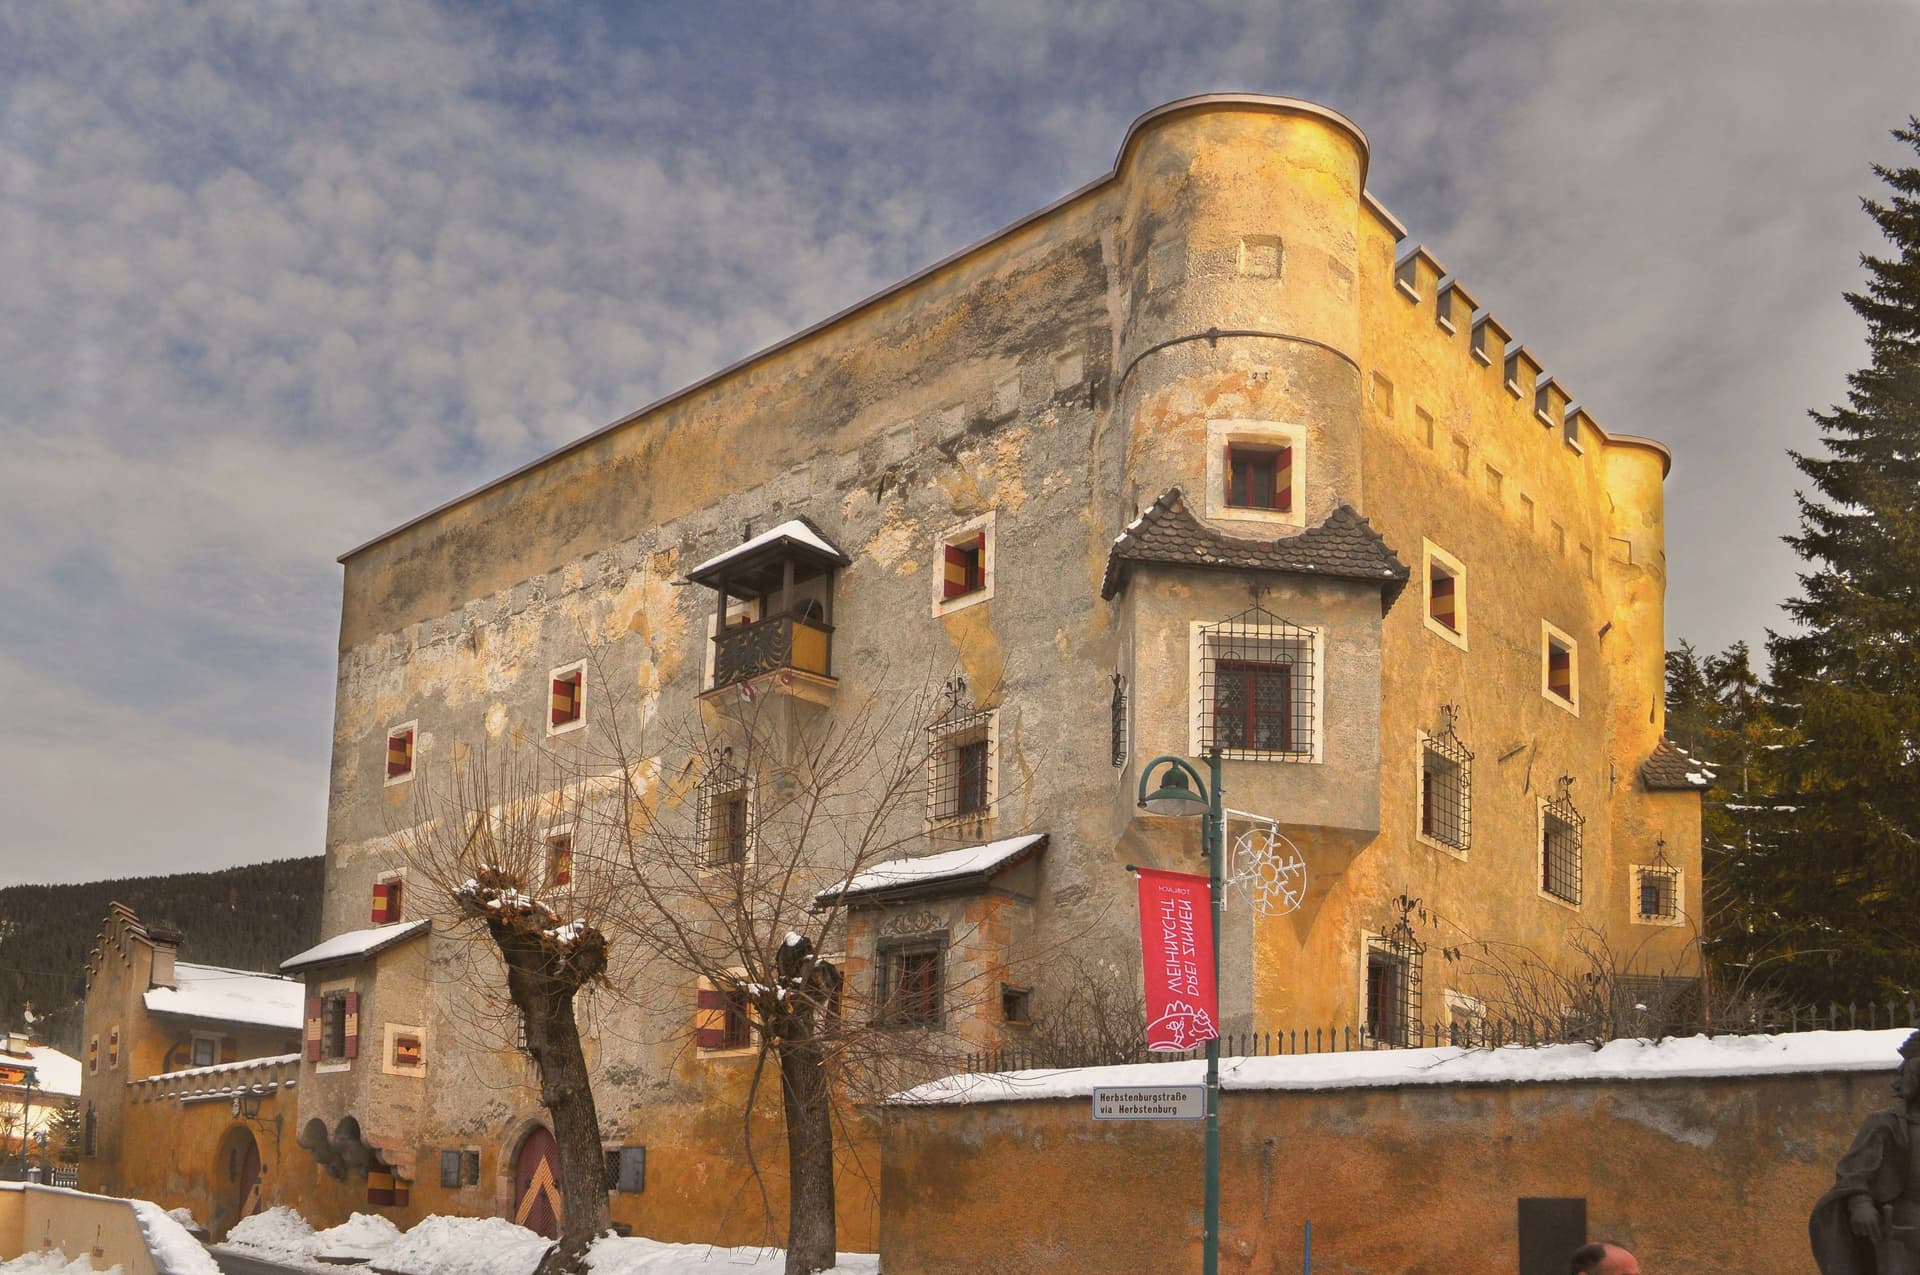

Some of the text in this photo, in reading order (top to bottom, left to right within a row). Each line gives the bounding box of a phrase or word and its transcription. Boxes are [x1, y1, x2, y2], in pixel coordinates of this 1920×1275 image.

[1100, 1092, 1187, 1103] Herbstenburgstraße
[1100, 1105, 1177, 1115] via Herbstenburg
